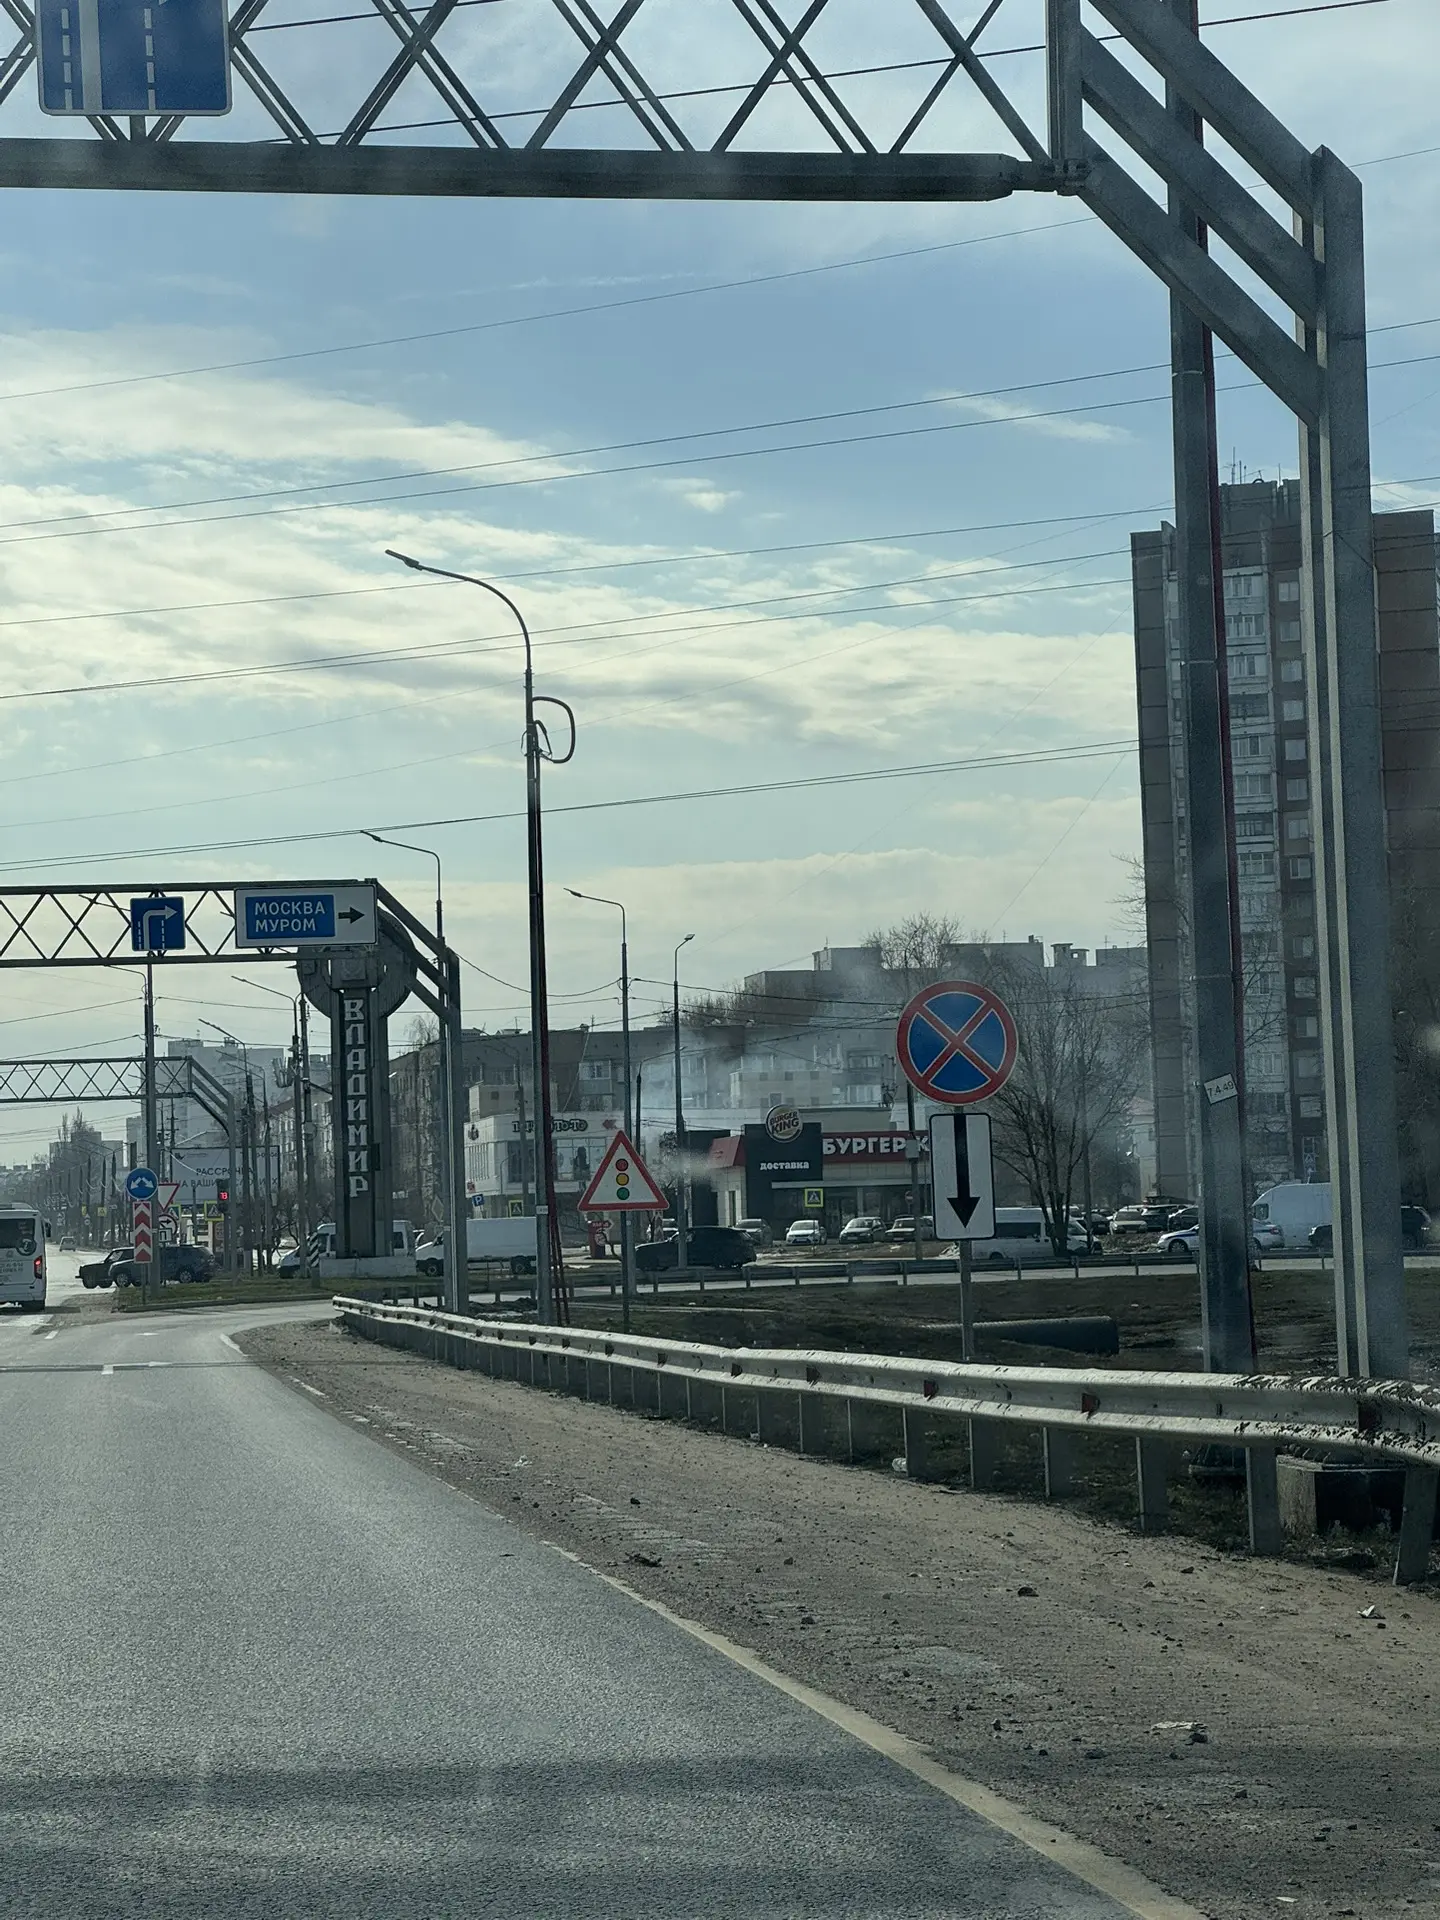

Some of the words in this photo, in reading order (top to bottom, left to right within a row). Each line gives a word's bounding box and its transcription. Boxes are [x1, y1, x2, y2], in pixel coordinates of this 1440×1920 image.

[255, 901, 326, 915] МОСКВА
[255, 918, 316, 932] МУРОМ
[344, 1000, 368, 1197] ВЛАДИМИР
[769, 1111, 798, 1125] BURGER
[771, 1118, 800, 1134] KING
[822, 1137, 906, 1155] БУРГЕР
[760, 1161, 810, 1171] доставка
